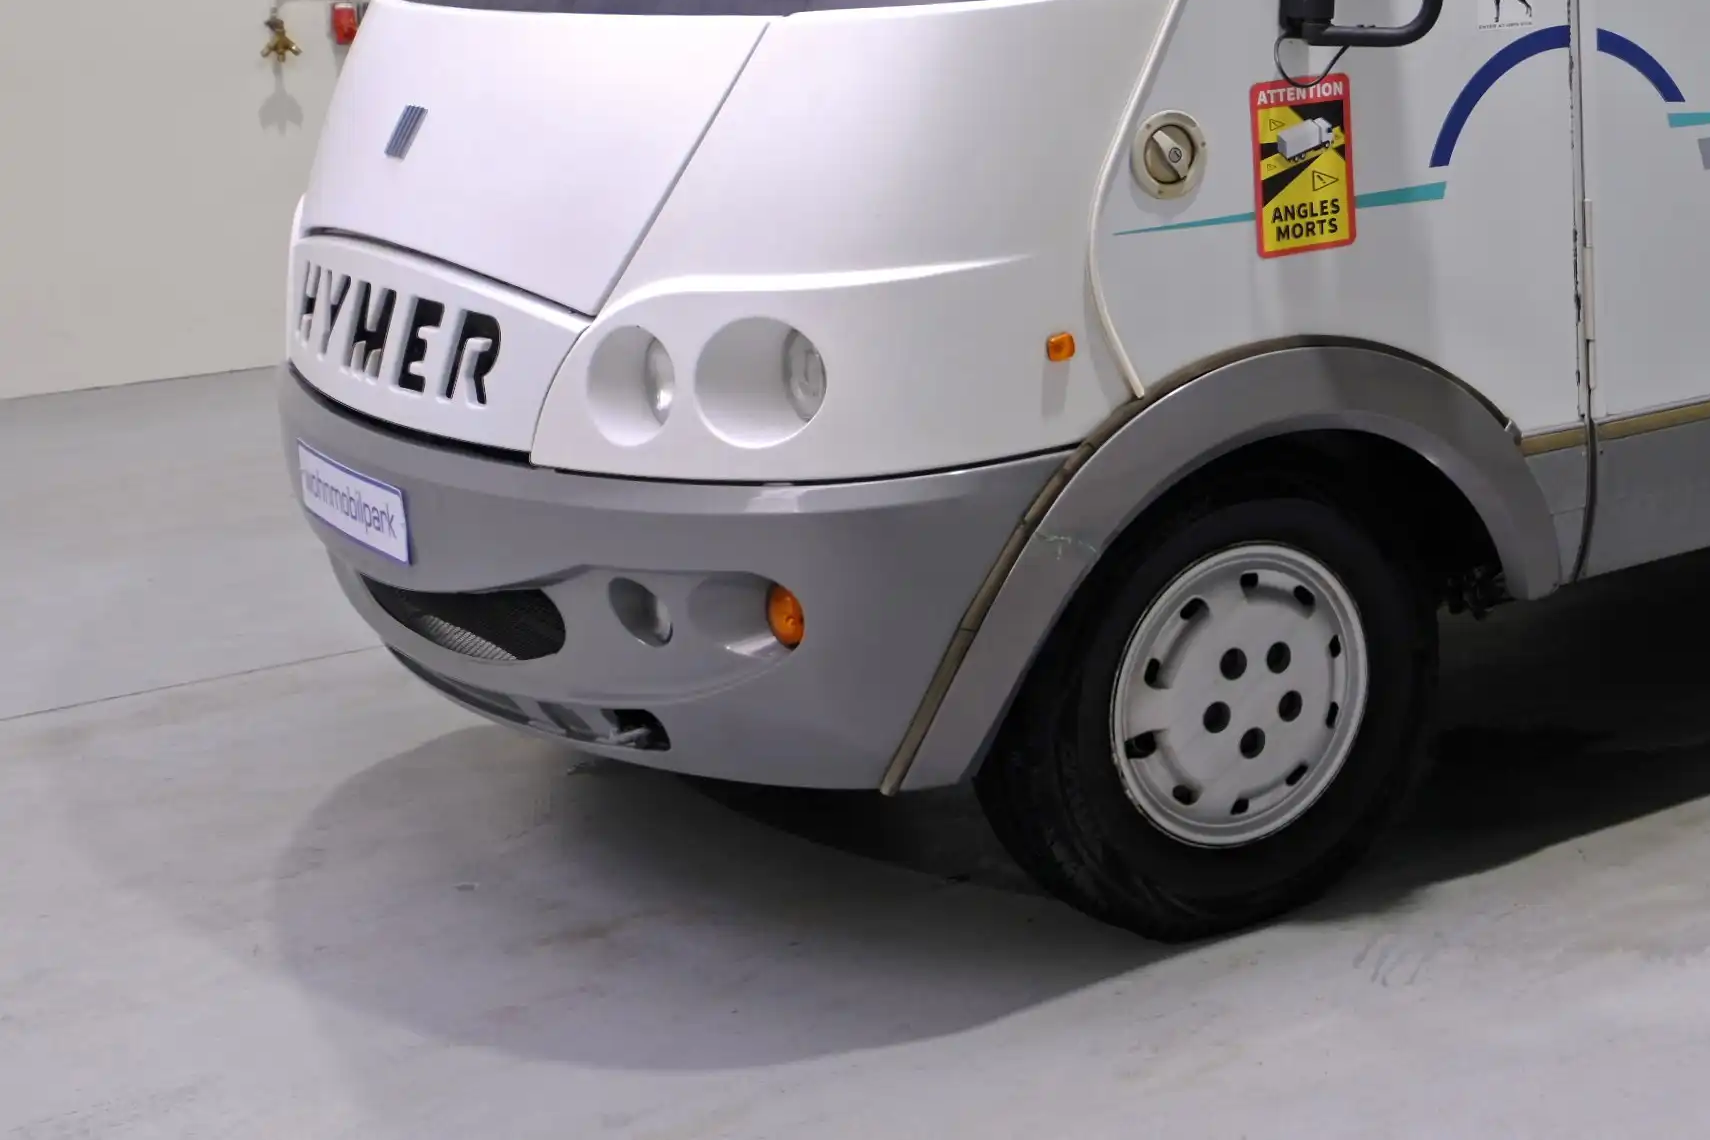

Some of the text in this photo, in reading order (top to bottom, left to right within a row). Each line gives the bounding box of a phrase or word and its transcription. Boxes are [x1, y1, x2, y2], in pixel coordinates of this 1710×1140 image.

[1257, 81, 1344, 106] ATTENTION
[1271, 198, 1341, 223] ANGLES
[1275, 217, 1339, 242] MORTS
[297, 260, 502, 406] HYMER
